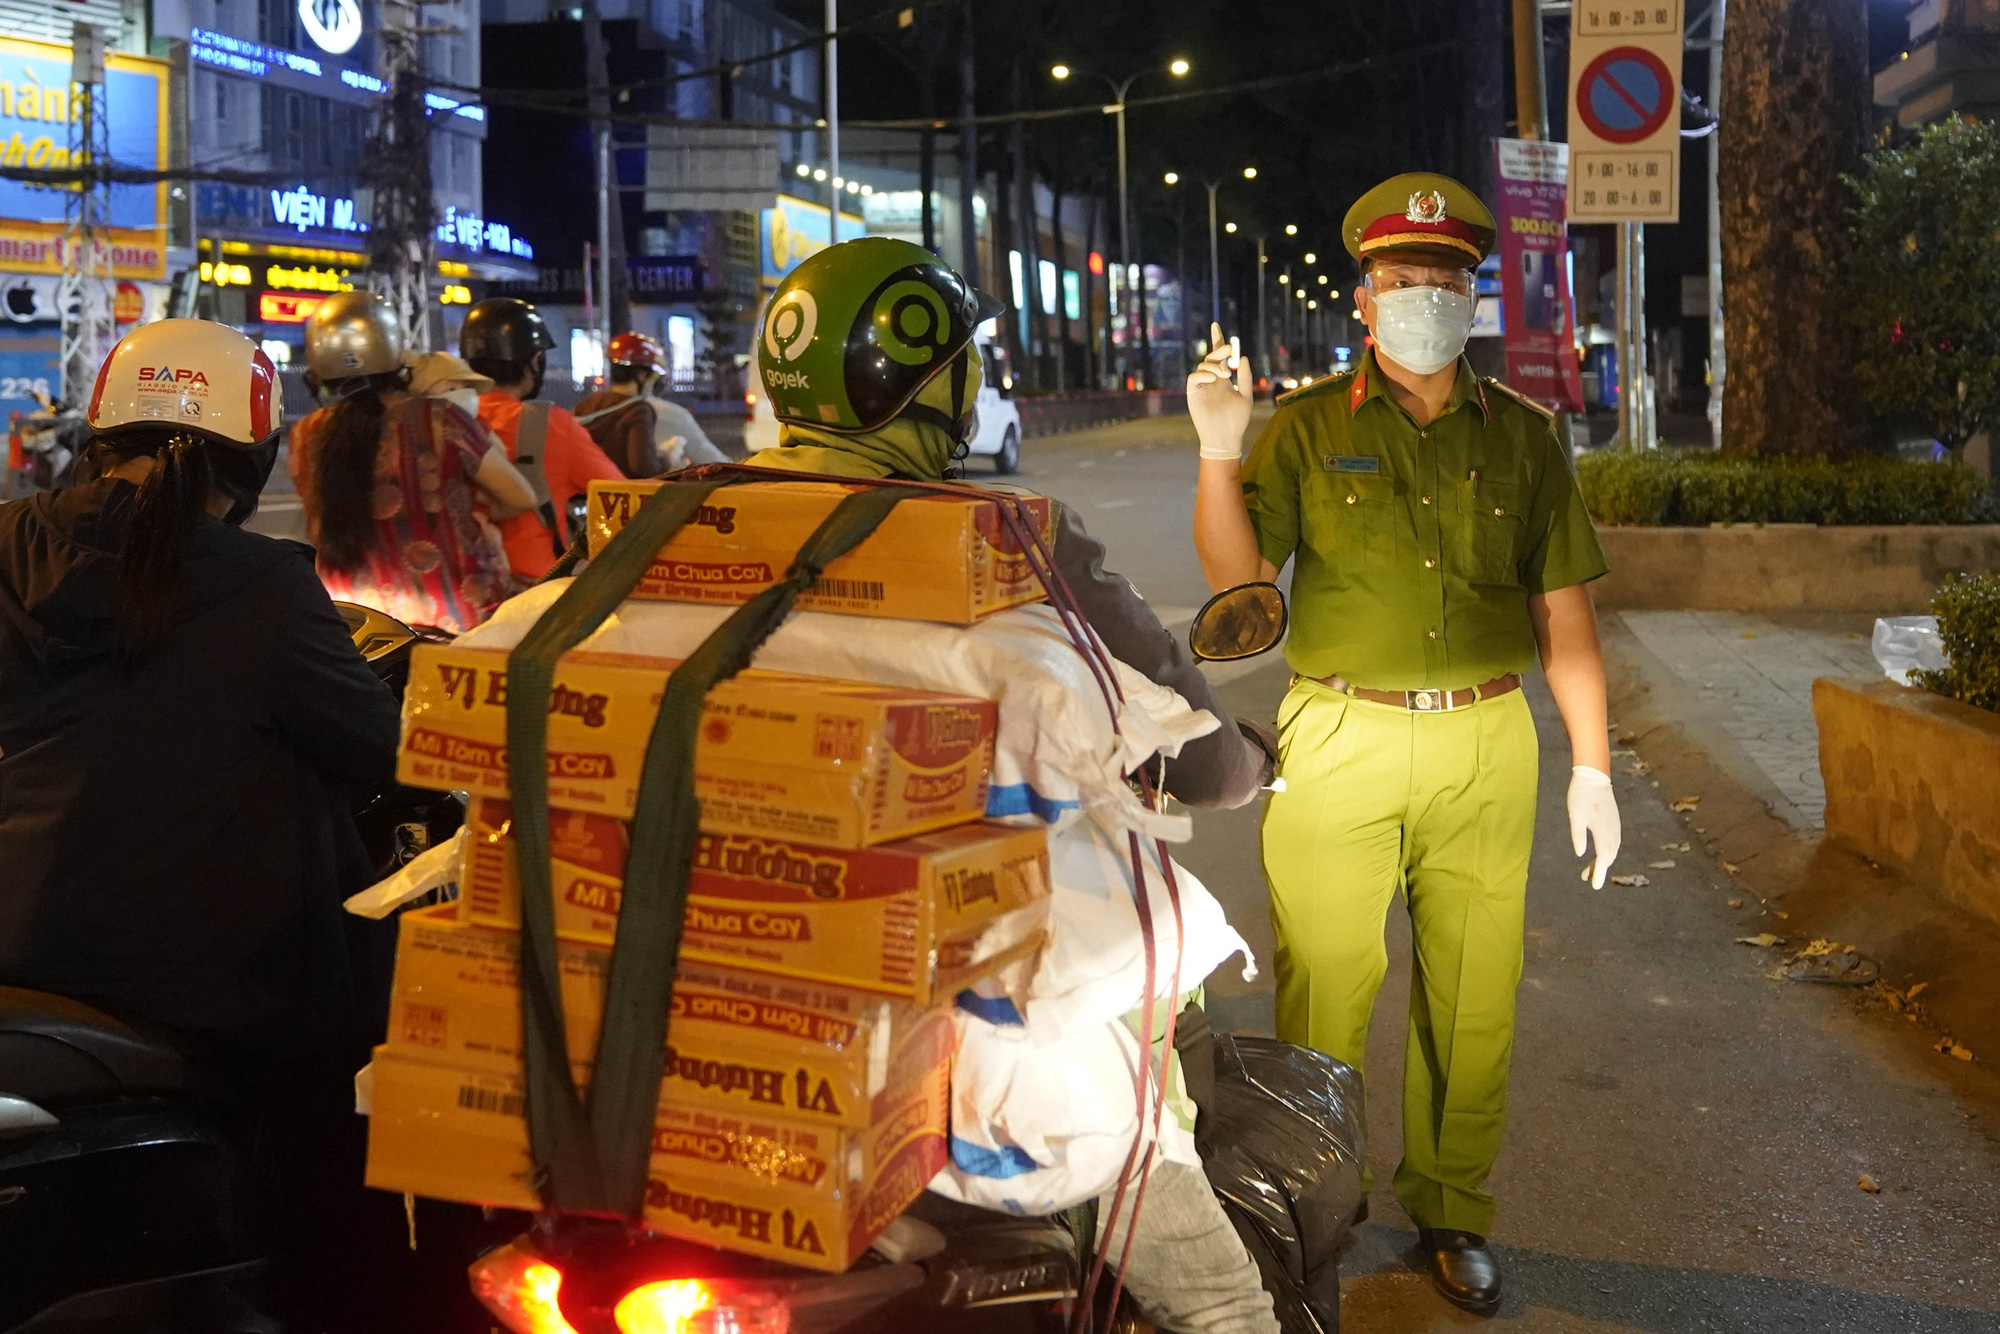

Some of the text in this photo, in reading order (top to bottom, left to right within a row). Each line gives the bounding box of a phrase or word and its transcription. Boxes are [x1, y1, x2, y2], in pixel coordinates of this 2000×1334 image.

[138, 366, 209, 387] SAPA
[766, 368, 810, 390] gojek
[675, 564, 723, 581] Chua
[727, 565, 765, 582] Cay
[560, 755, 607, 777] Cay
[749, 913, 801, 939] Cay
[692, 998, 757, 1025] Chua
